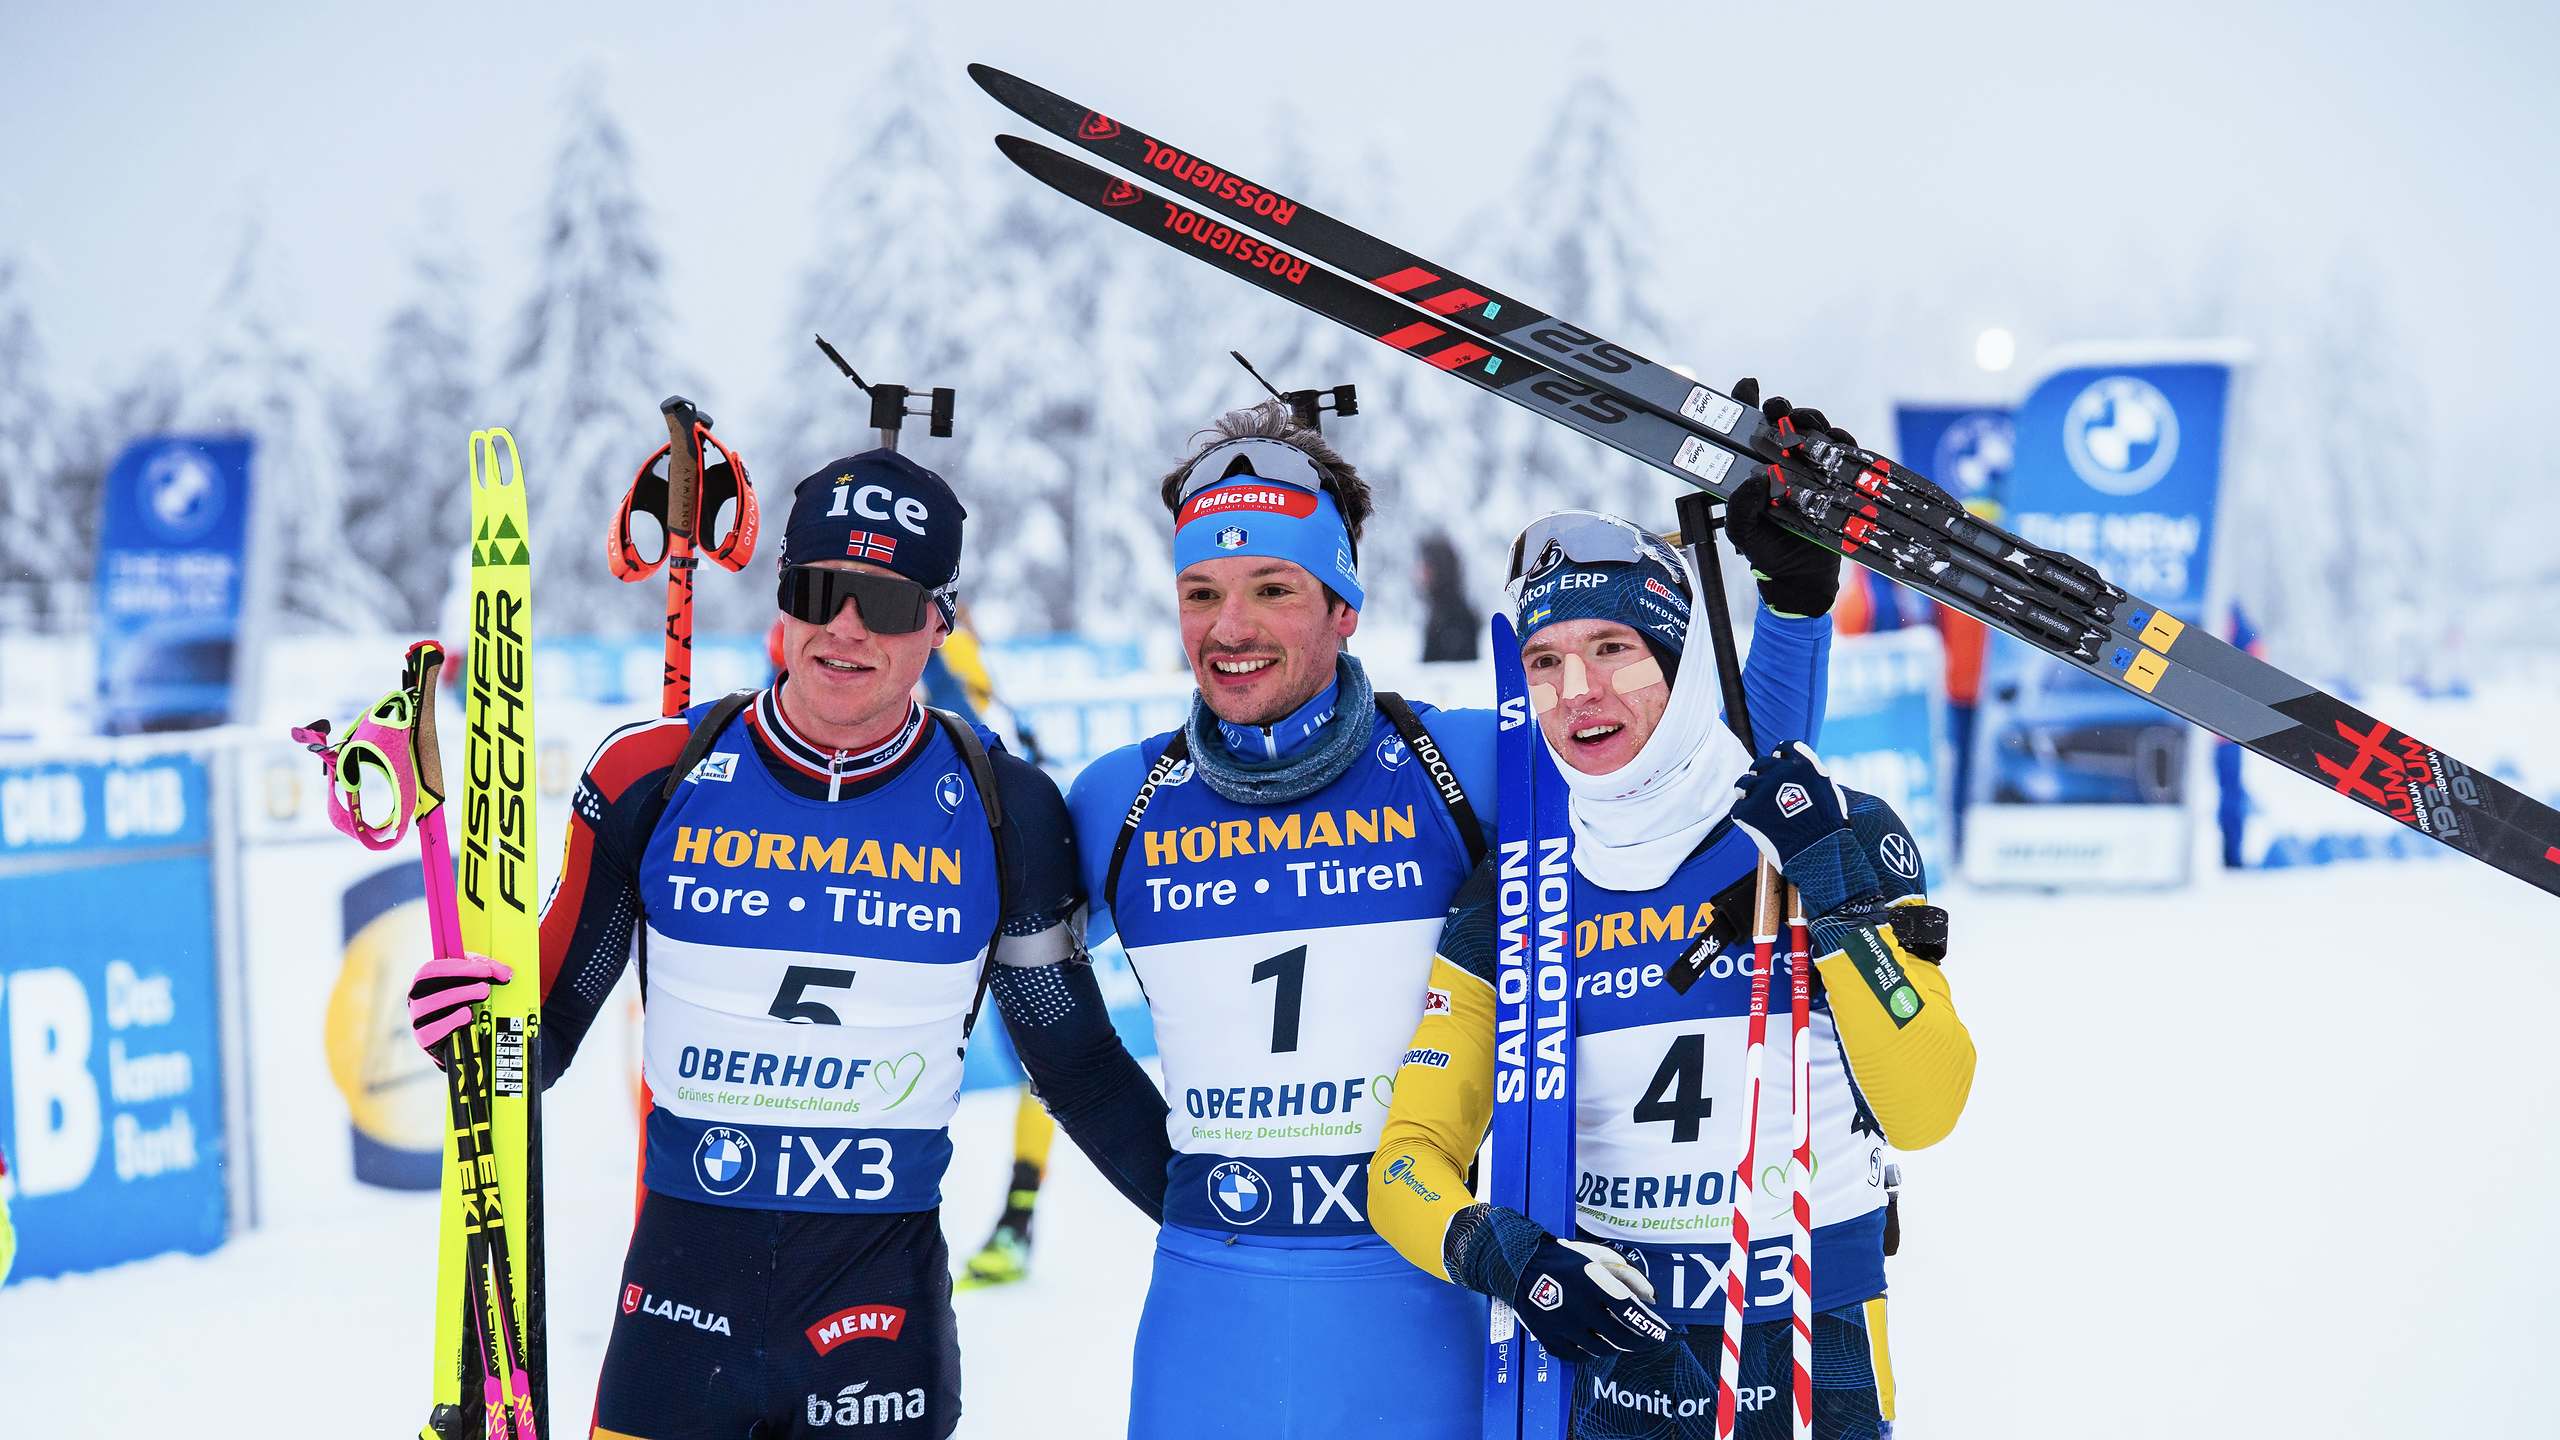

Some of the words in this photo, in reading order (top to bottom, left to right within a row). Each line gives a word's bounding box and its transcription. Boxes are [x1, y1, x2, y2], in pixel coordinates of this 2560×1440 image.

[1142, 138, 1298, 226] ROSSIGNOL
[1164, 203, 1311, 285] ROSSIGNOL
[826, 478, 928, 536] ice
[1193, 491, 1285, 514] felicetti
[941, 594, 957, 616] RAFT
[1559, 573, 1608, 590] ERP
[1640, 598, 1686, 629] SWEDEMO
[465, 591, 491, 912] FISCHER
[496, 590, 525, 913] FISCHER
[1413, 734, 1464, 805] FIOCCHI
[1124, 755, 1174, 829] FIOCCHI
[672, 825, 962, 886] HÖRMANN
[1143, 804, 1417, 868] HÖRMANN
[667, 875, 770, 916] Tore
[825, 886, 962, 935] Türen
[1146, 878, 1237, 914] Tore
[1286, 860, 1424, 898] Türen
[767, 965, 857, 1027] 5
[1251, 944, 1308, 1054] 1
[1497, 840, 1528, 1104] SALOMON
[1535, 837, 1568, 1101] SALOMON
[1576, 961, 1664, 1000] rage
[678, 1045, 873, 1090] OBERHOF
[1633, 1033, 1713, 1143] 4
[677, 1087, 715, 1104] Grünes
[718, 1091, 751, 1107] Herz
[754, 1094, 861, 1114] Deutschlands
[1186, 1077, 1366, 1120] OBERHOF
[1225, 1126, 1254, 1141] Herz
[1257, 1121, 1363, 1139] Deutschlands
[473, 1122, 504, 1228] LEKI
[775, 1134, 896, 1201] iX3
[1291, 1164, 1368, 1225] iX
[1641, 1214, 1734, 1230] Deutschlan
[1672, 1246, 1796, 1309] iX3
[642, 1294, 732, 1337] LAPUA
[817, 1312, 897, 1345] MENY
[1622, 1306, 1668, 1343] HESTRA
[1593, 1376, 1710, 1419] Monitor
[1718, 1386, 1778, 1413] RP
